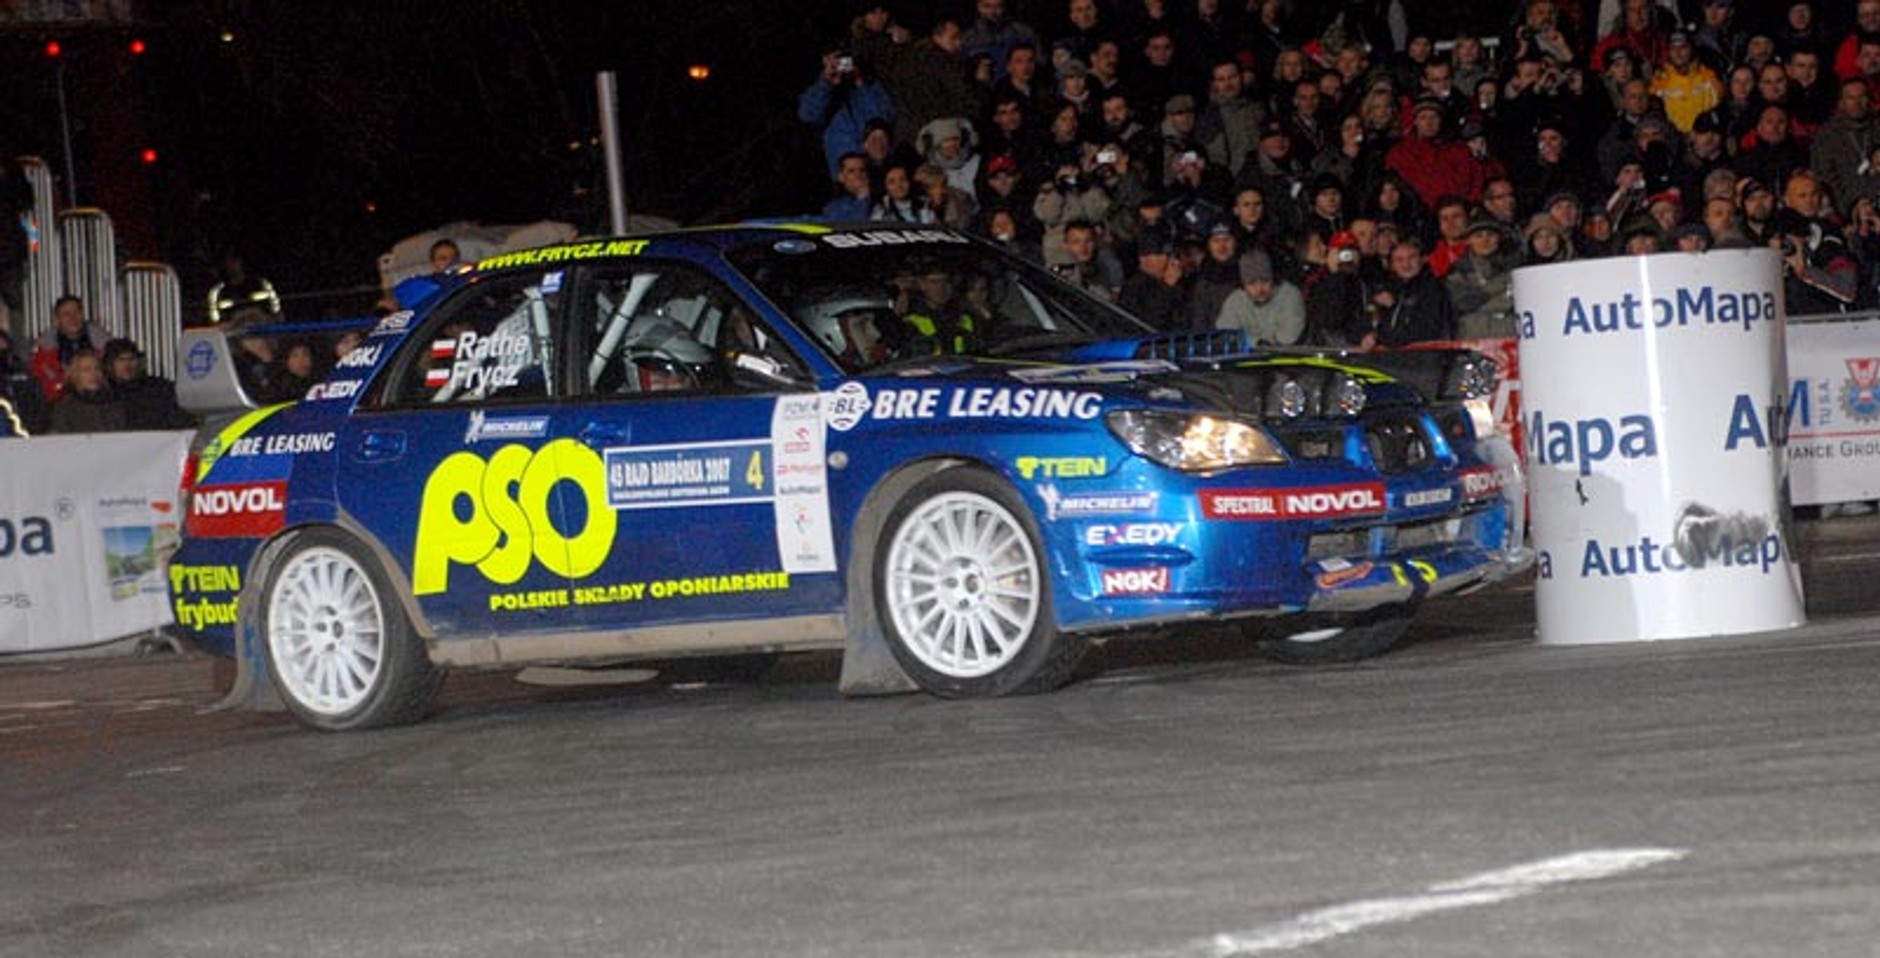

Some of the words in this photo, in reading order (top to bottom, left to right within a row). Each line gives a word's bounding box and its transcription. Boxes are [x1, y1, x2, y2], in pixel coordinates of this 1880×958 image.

[822, 229, 969, 249] SUBARU
[477, 239, 650, 271] WWW.FRYCZ.NET
[1563, 286, 1775, 336] AutoMapa
[455, 331, 530, 361] Rathe
[451, 361, 520, 389] Frycz
[872, 388, 941, 420] BRE
[949, 387, 1104, 420] LEASING
[481, 418, 546, 432] MICHELIN
[229, 435, 264, 457] BRE
[264, 432, 335, 454] LEASING
[746, 450, 765, 490] 4
[1041, 457, 1107, 477] TEIN
[193, 488, 285, 516] NOVOL
[1060, 494, 1152, 510] MICHELIN
[1212, 495, 1276, 514] SPECTRAL
[1287, 489, 1382, 513] NOVOL
[413, 437, 618, 596] PSO
[1086, 522, 1185, 545] EXEDY
[489, 589, 569, 611] POLSKIE
[573, 582, 645, 606] SKŁADY
[650, 571, 791, 597] OPONIARSKIE
